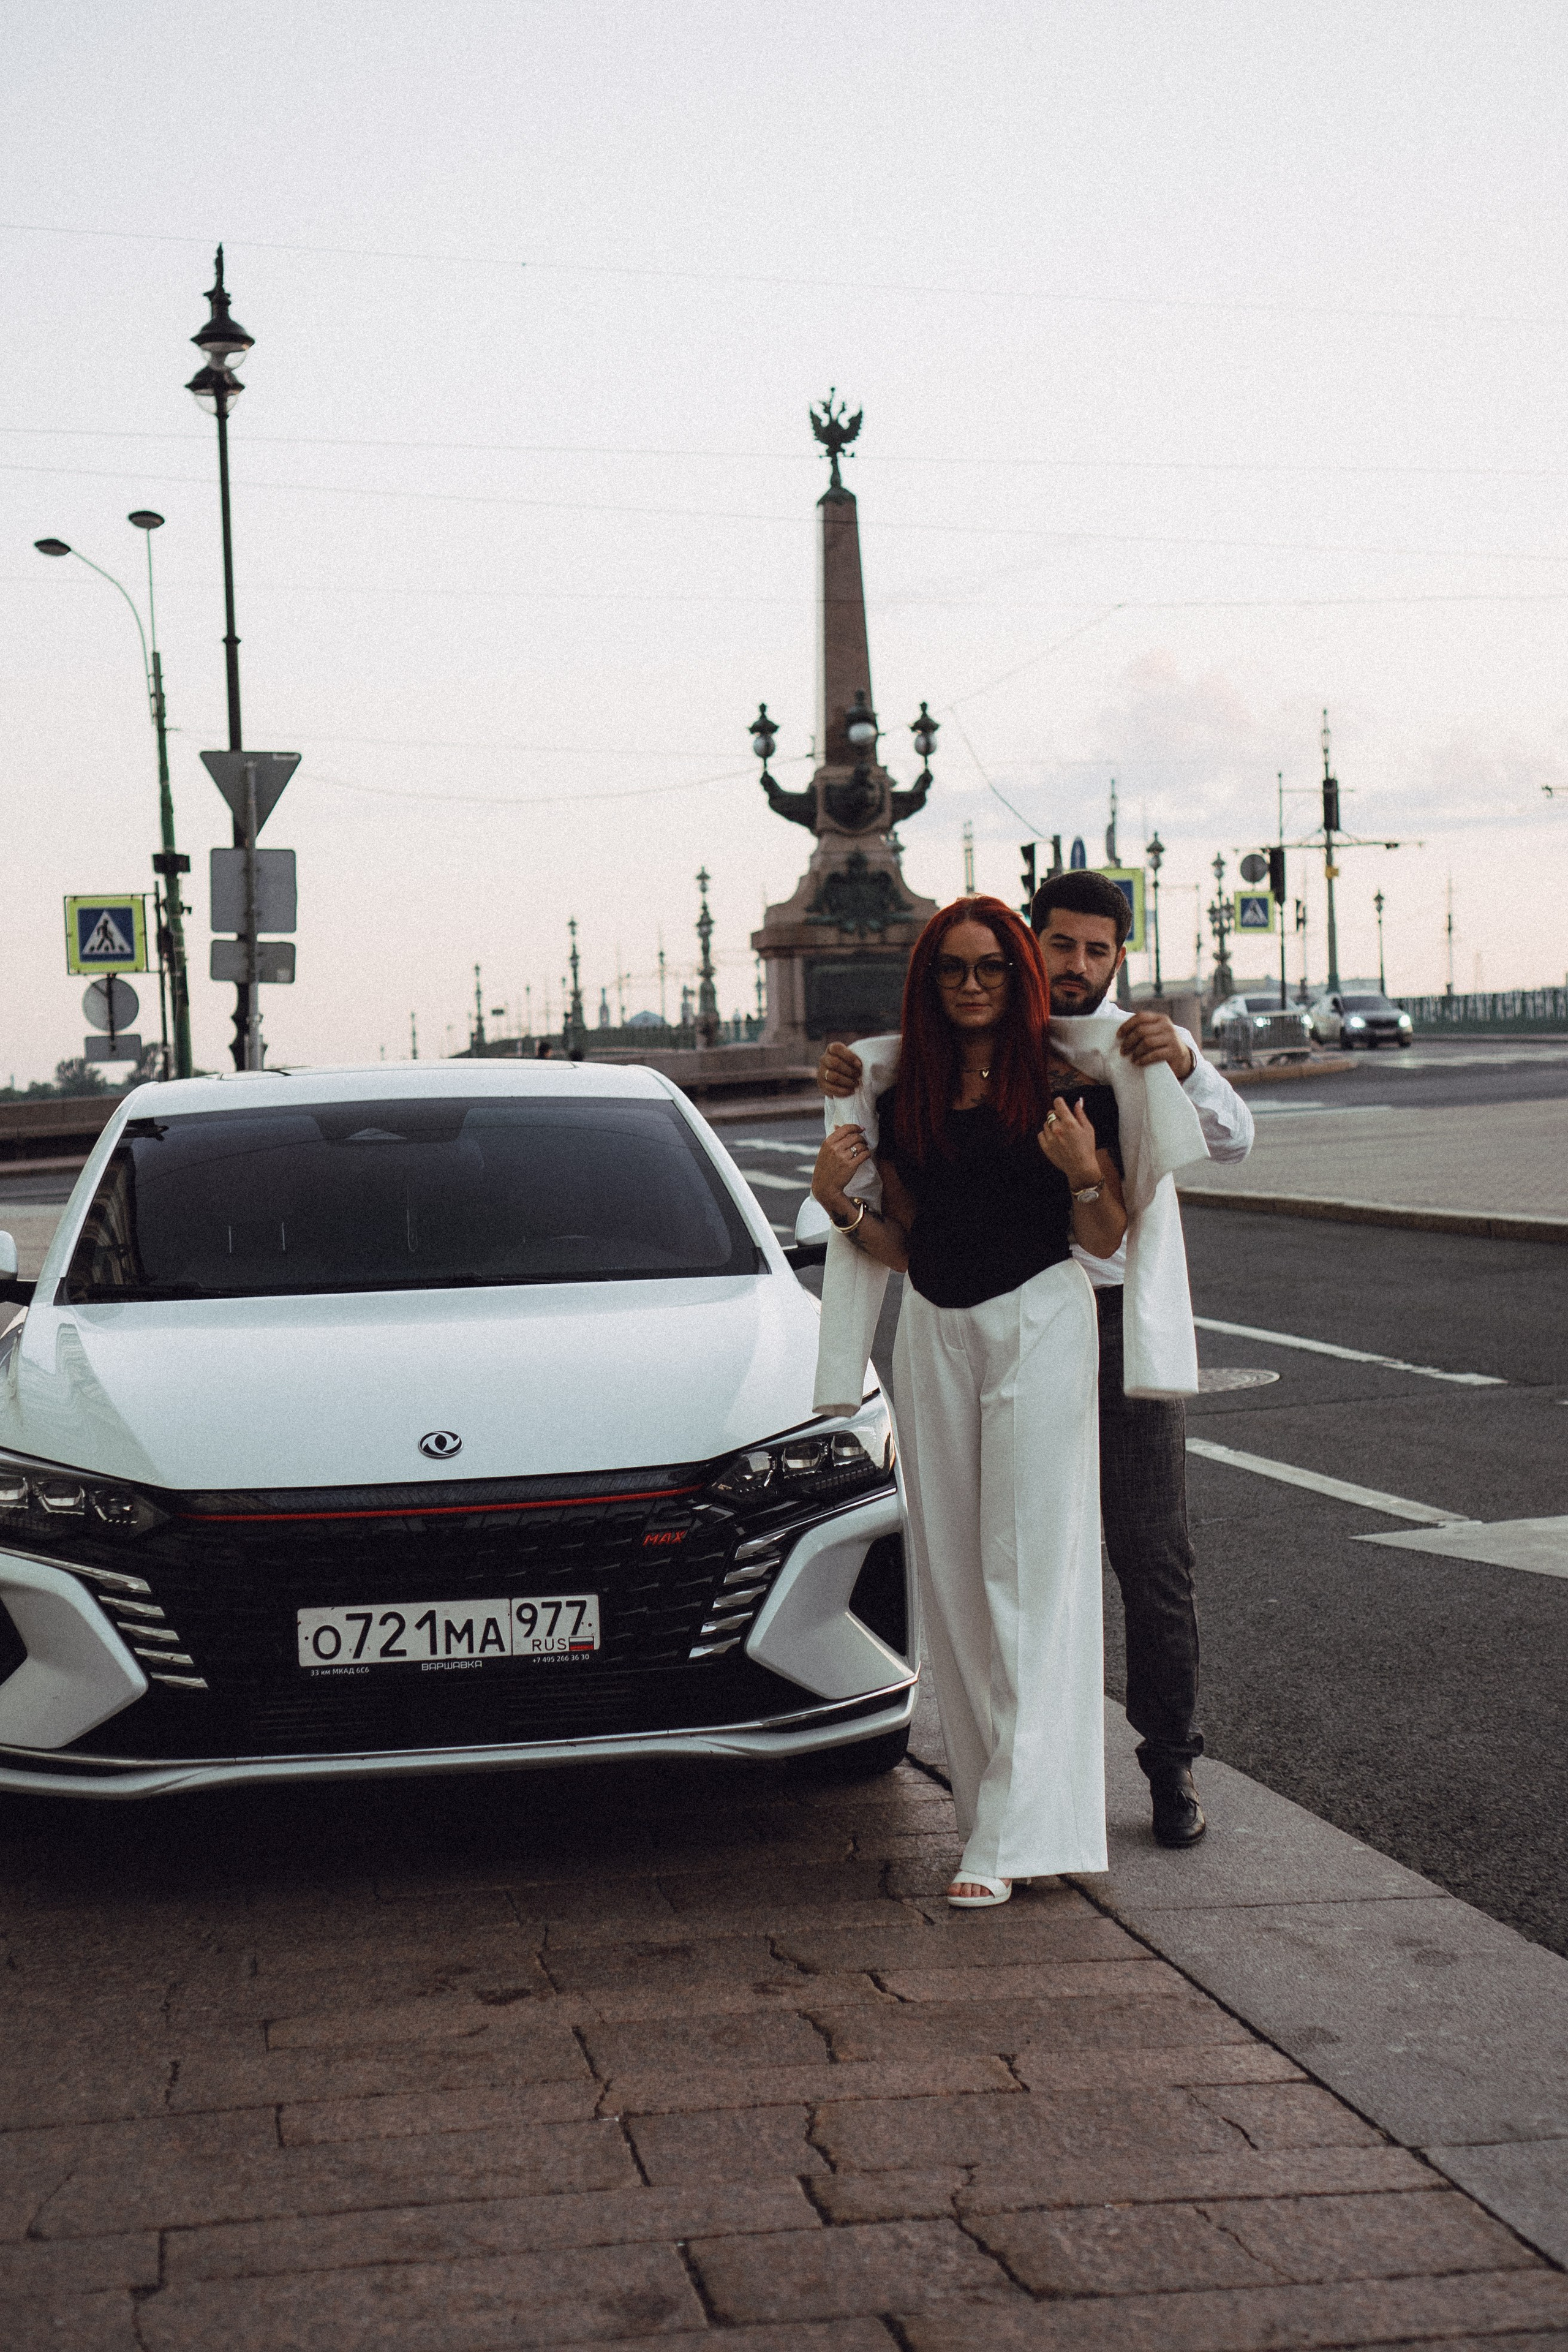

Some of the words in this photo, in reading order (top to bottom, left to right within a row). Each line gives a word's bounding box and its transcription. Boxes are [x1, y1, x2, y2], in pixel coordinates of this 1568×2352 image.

[643, 1531, 686, 1546] MAX
[516, 1600, 587, 1638] 977
[532, 1638, 567, 1652] RUS
[421, 1660, 483, 1671] ВАРШАВКА
